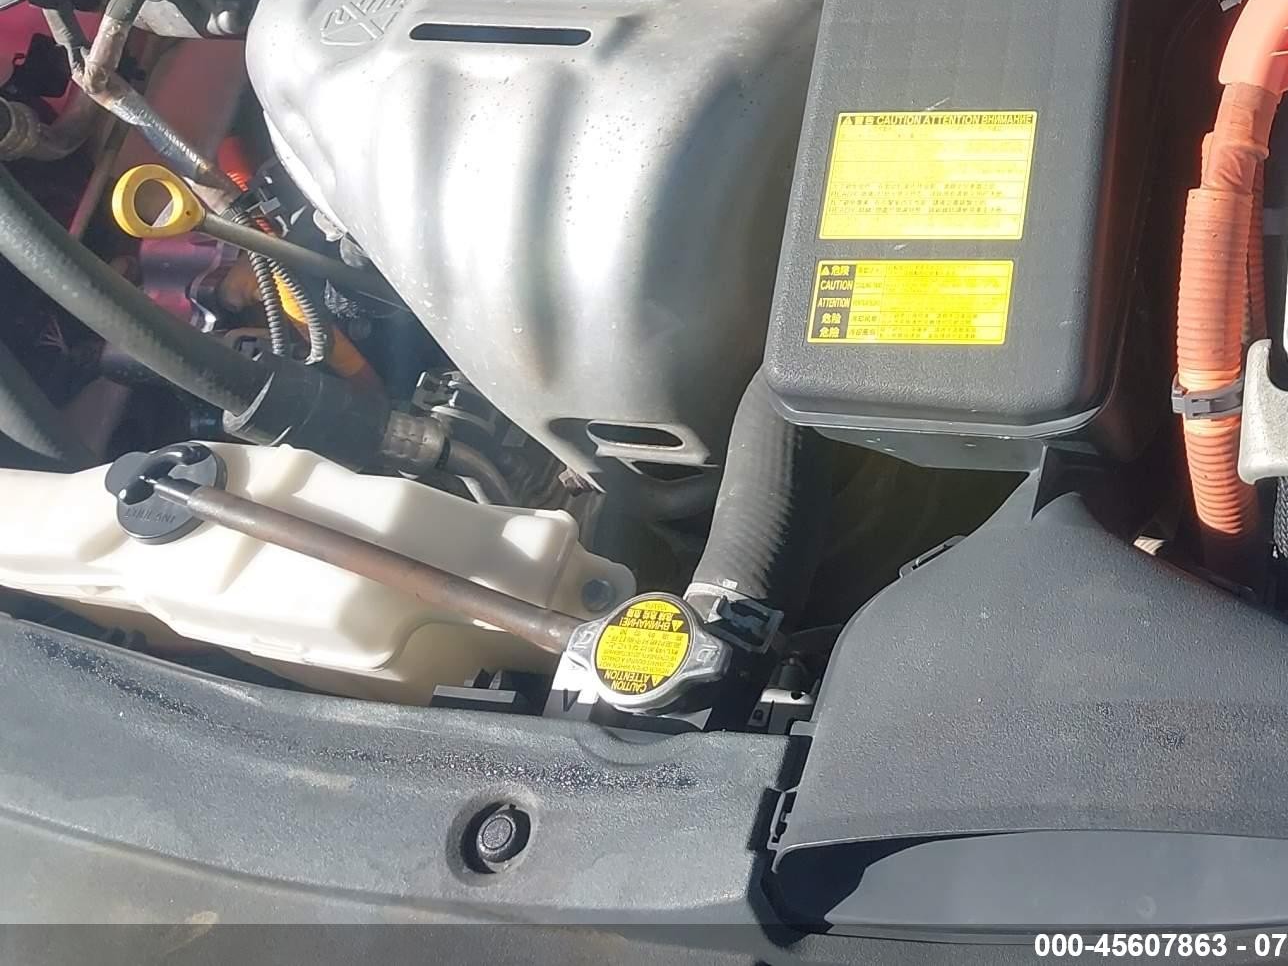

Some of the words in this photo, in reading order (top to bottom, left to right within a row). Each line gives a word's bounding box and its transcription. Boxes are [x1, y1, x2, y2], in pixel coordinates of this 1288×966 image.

[877, 114, 922, 126] CAUTION
[923, 114, 978, 125] ATTENTION
[979, 114, 1033, 125] ВНИМАНИЕ
[820, 280, 853, 291] CAUTION
[817, 297, 851, 308] ATTENTION
[620, 617, 671, 631] ВНИМАНИЕ!
[604, 669, 651, 683] ATTENTION
[611, 680, 647, 693] CAUTION
